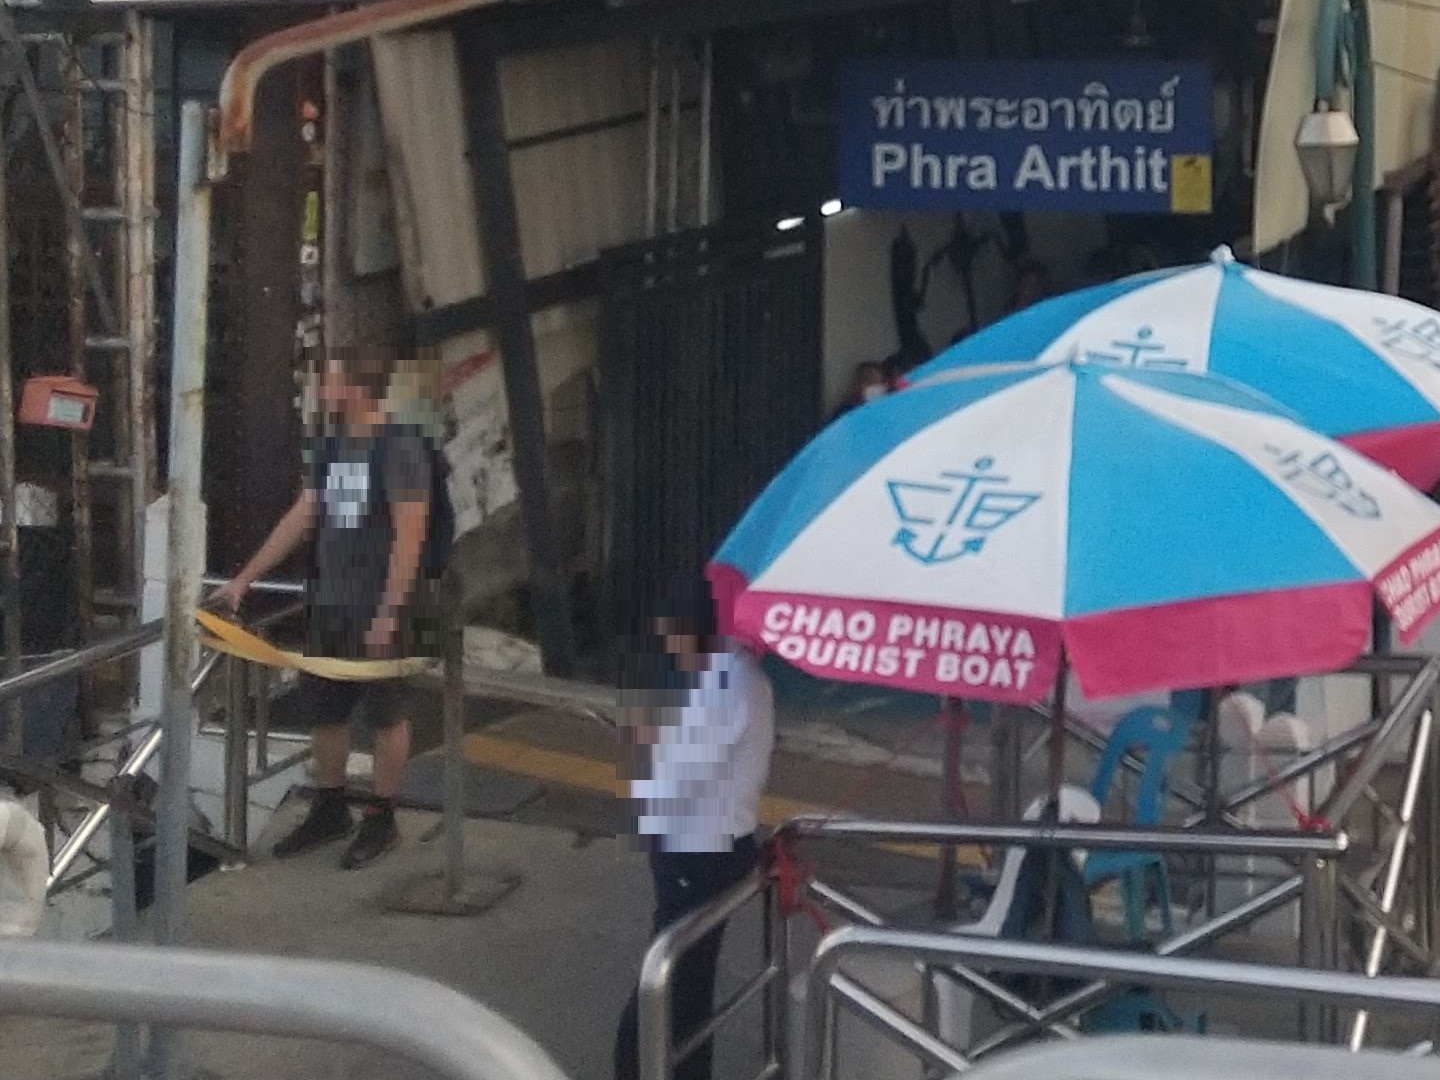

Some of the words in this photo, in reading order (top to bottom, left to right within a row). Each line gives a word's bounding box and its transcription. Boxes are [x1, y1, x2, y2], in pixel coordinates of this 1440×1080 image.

[871, 75, 1181, 134] ท่าพระอาทิตย์
[871, 142, 997, 190] Phra
[1014, 143, 1170, 193] Arthit
[763, 601, 876, 642] CHAO
[887, 612, 1036, 660] PHRAYA
[934, 649, 1035, 691] BOAT
